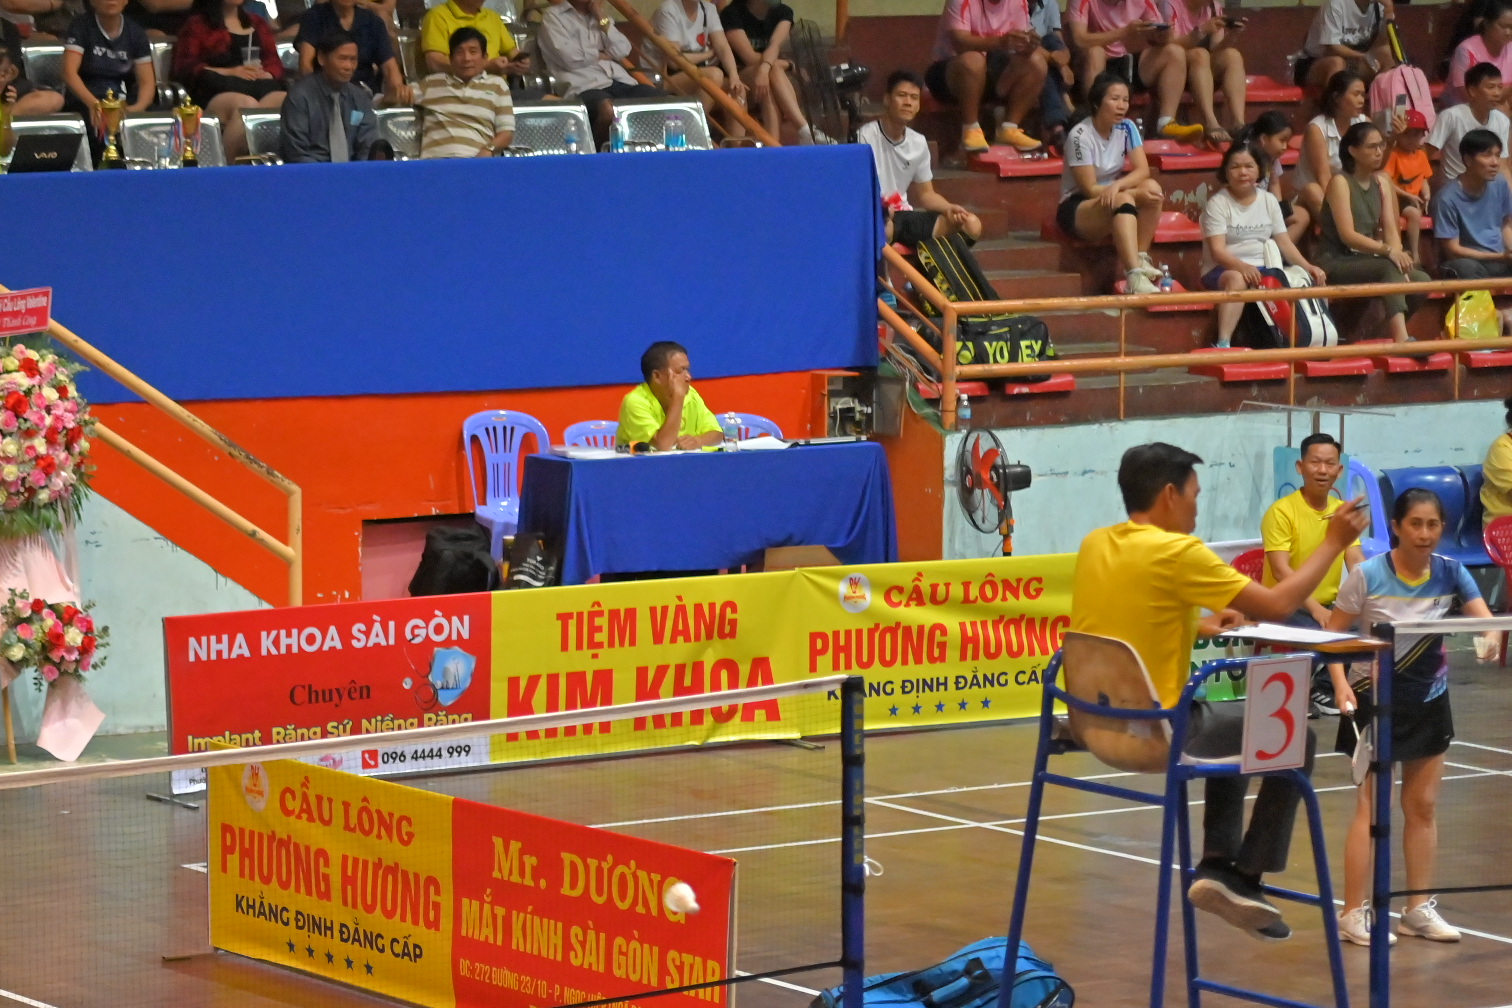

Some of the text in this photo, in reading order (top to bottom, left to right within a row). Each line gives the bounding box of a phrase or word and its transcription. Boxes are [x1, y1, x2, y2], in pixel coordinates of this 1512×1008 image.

[34, 151, 58, 159] VAIO
[1073, 136, 1083, 162] YONEX
[984, 339, 1042, 363] YOEX
[883, 571, 1044, 609] CẦU LÔNG
[188, 609, 470, 662] NHA KHOA SÀI GÒN
[556, 595, 738, 659] TIỆM VÀNG
[808, 613, 1072, 673] PHƯƠNG HƯƠNG
[288, 680, 372, 709] Chuyên
[506, 656, 781, 742] KIM KHOA
[900, 675, 948, 699] ĐỊNH
[954, 666, 1009, 691] ĐẲNG
[272, 725, 321, 745] Răng
[327, 718, 353, 738] Sứ
[361, 713, 418, 734] Niềng
[1255, 671, 1295, 761] 3
[381, 744, 472, 765] 096 4444 999
[279, 775, 415, 847] CẦU LÔNG
[221, 822, 441, 931] PHƯƠNG HƯƠNG
[491, 835, 547, 890] Mr.
[235, 891, 423, 964] KHẲNG ĐỊNH ĐẲNG CẤP
[461, 888, 720, 1004] MẮT KÍNH SÀI GÒN STAR
[474, 962, 490, 983] 272
[491, 966, 519, 992] ĐƯỜNG
[520, 975, 547, 999] 23/10
